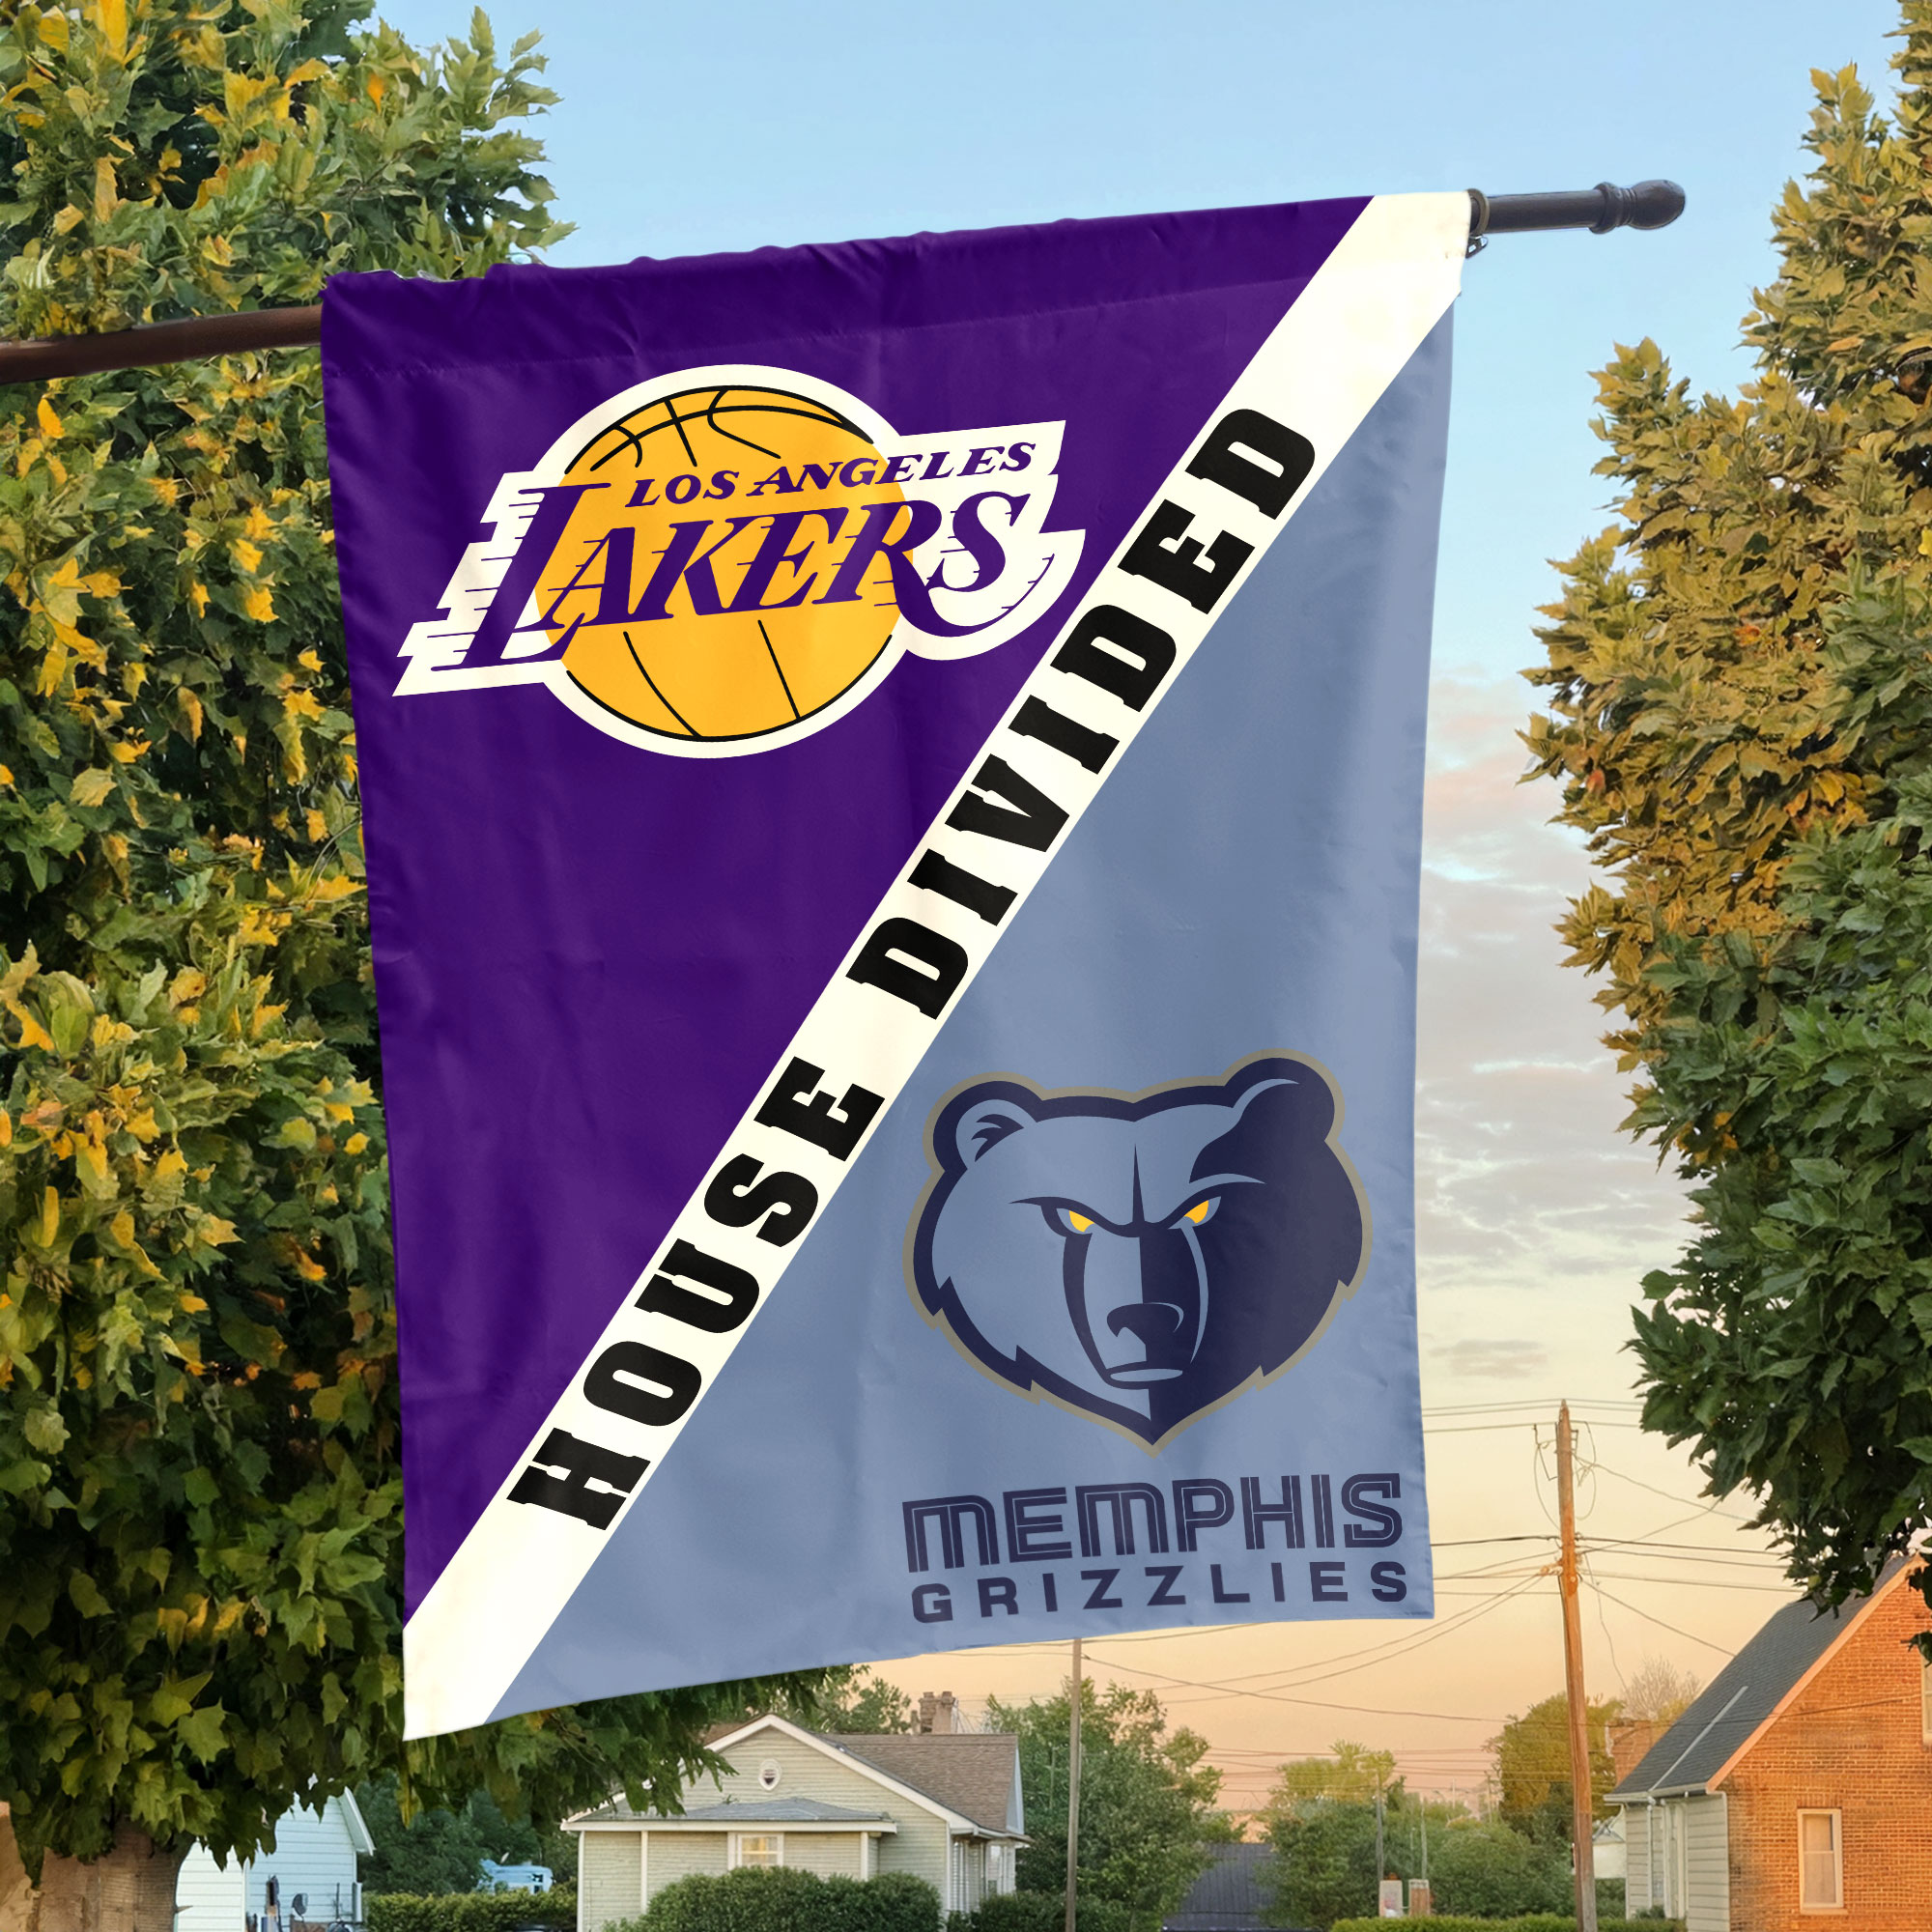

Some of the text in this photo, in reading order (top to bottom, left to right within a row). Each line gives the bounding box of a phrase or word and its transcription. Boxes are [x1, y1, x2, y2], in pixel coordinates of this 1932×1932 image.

[625, 441, 1036, 507] LOS ANGELES
[428, 483, 1055, 671] LAKERS
[506, 409, 1316, 1531] HOUSE DIVIDED
[902, 1472, 1403, 1573] MEMPHIS
[911, 1561, 1407, 1623] GRIZZLIES
